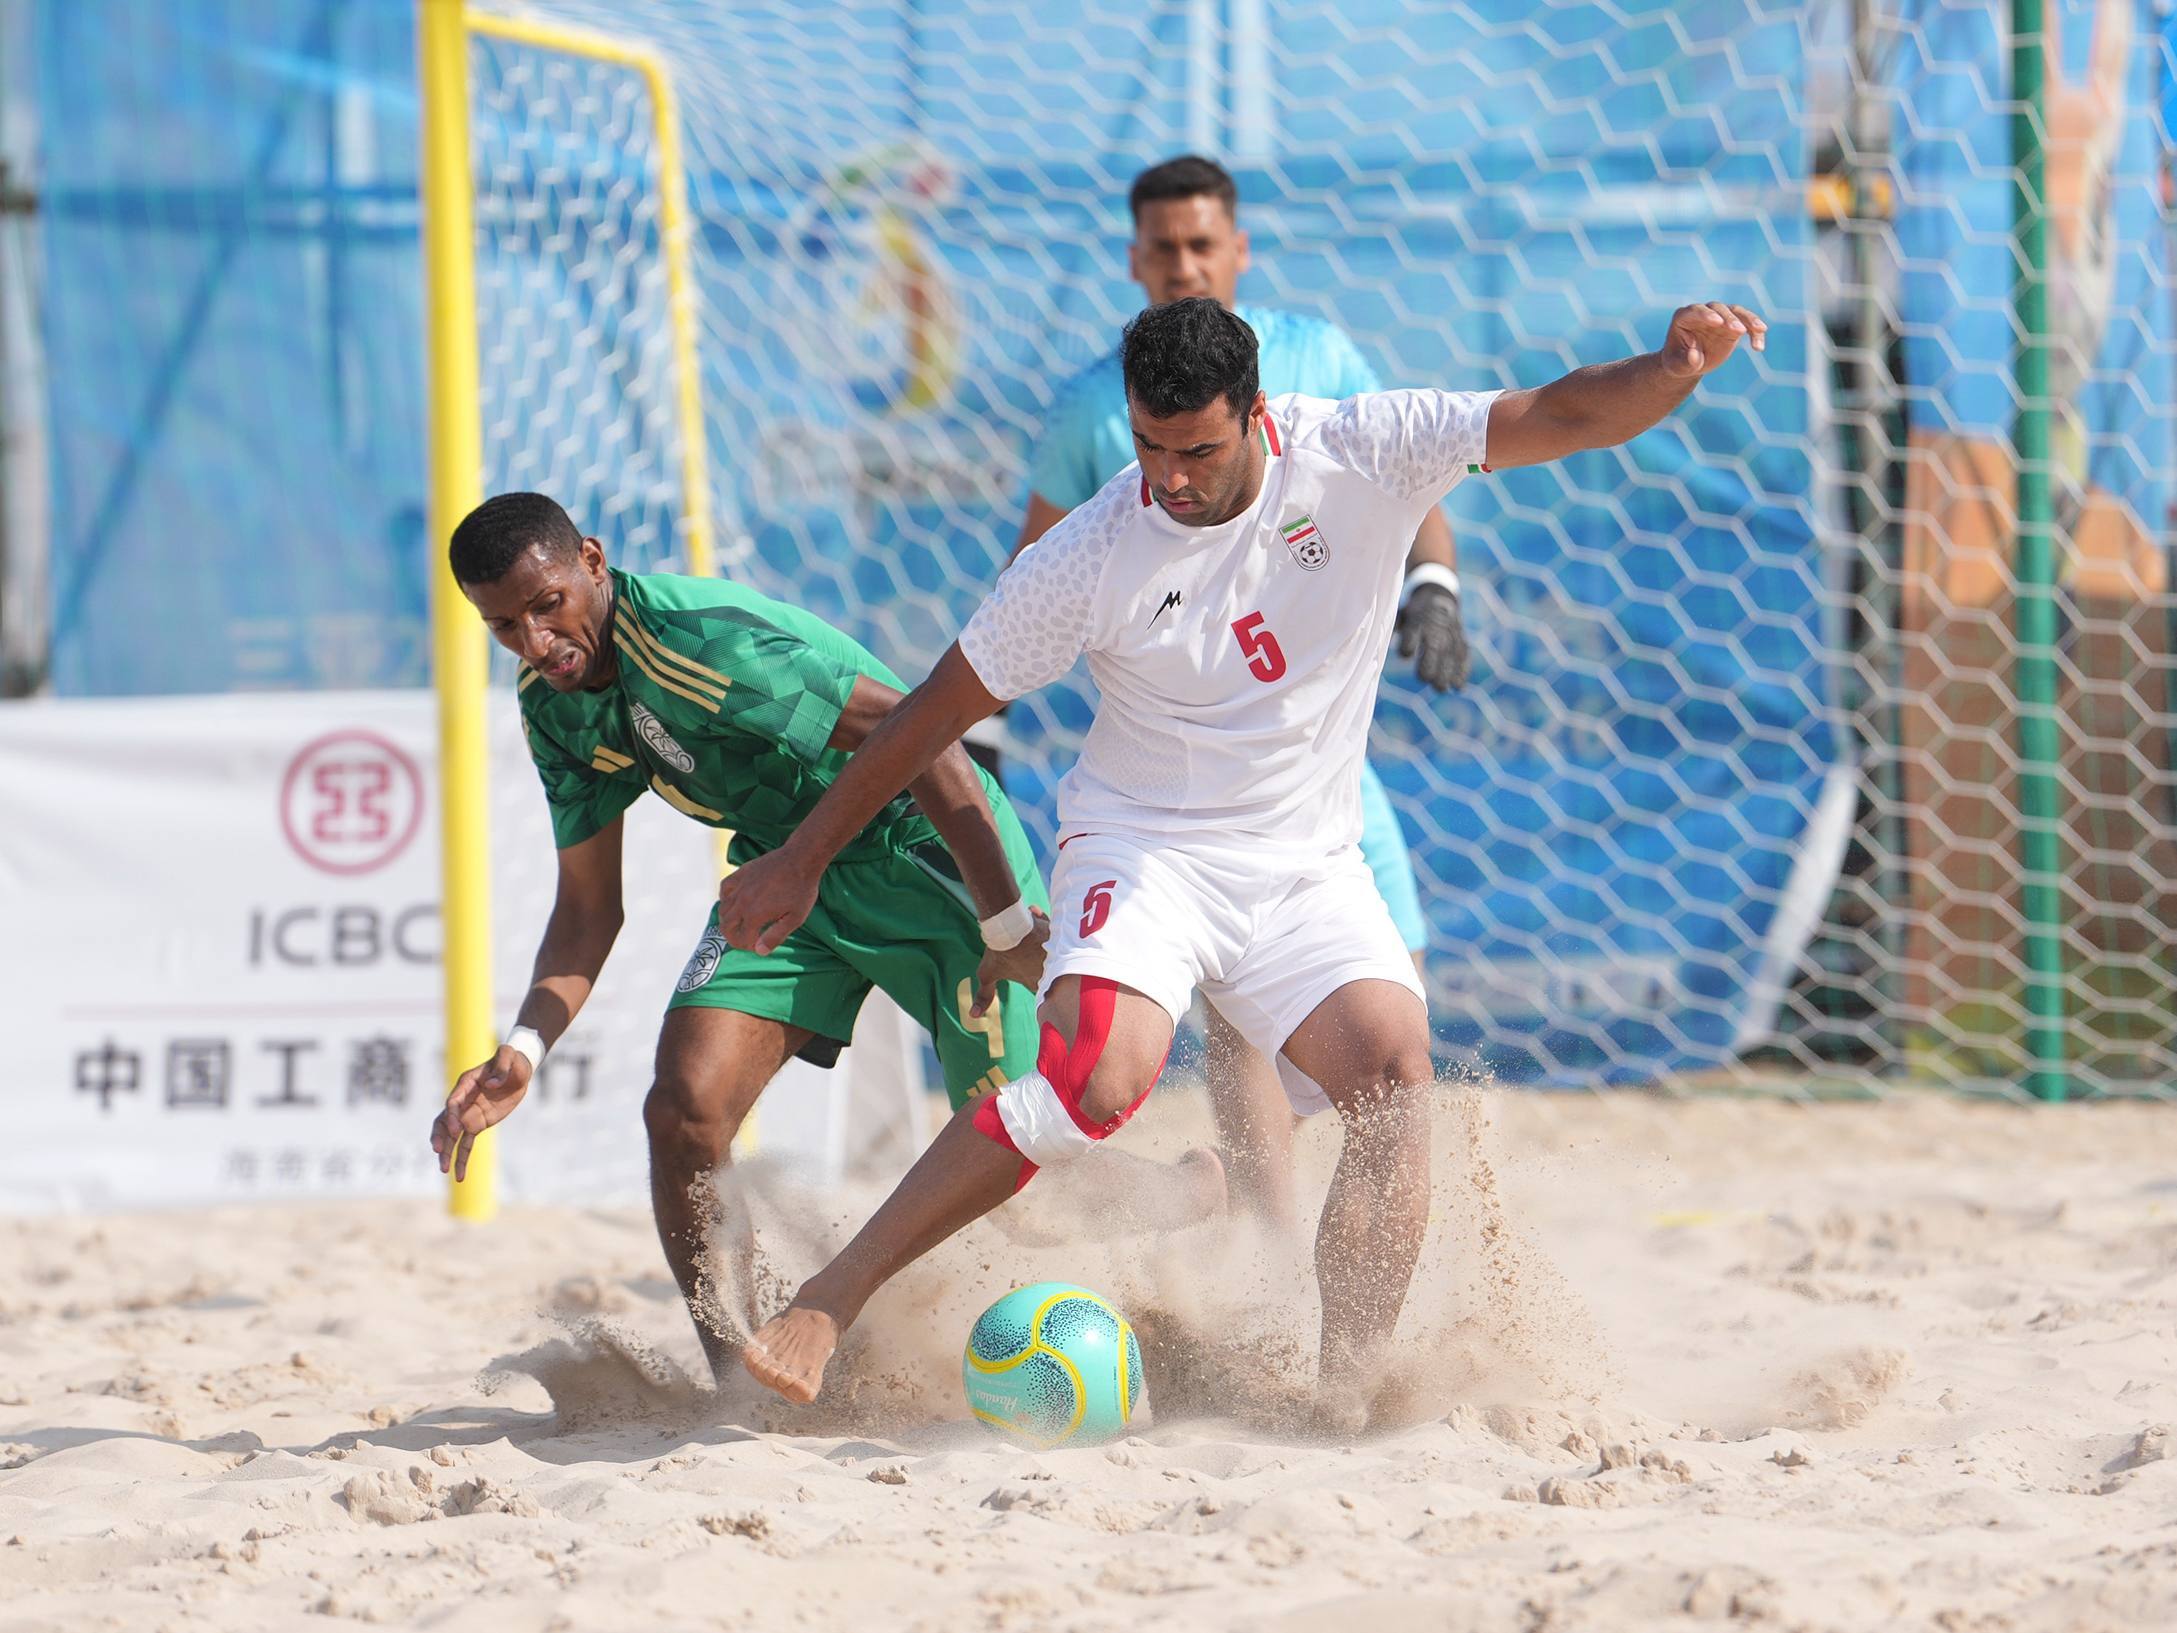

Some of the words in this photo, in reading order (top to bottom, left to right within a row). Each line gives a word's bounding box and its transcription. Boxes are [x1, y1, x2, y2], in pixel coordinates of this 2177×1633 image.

[1230, 610, 1288, 683] 5
[247, 903, 444, 967] ICBC
[1078, 879, 1117, 939] 5
[72, 1032, 594, 1113] 中国工商行
